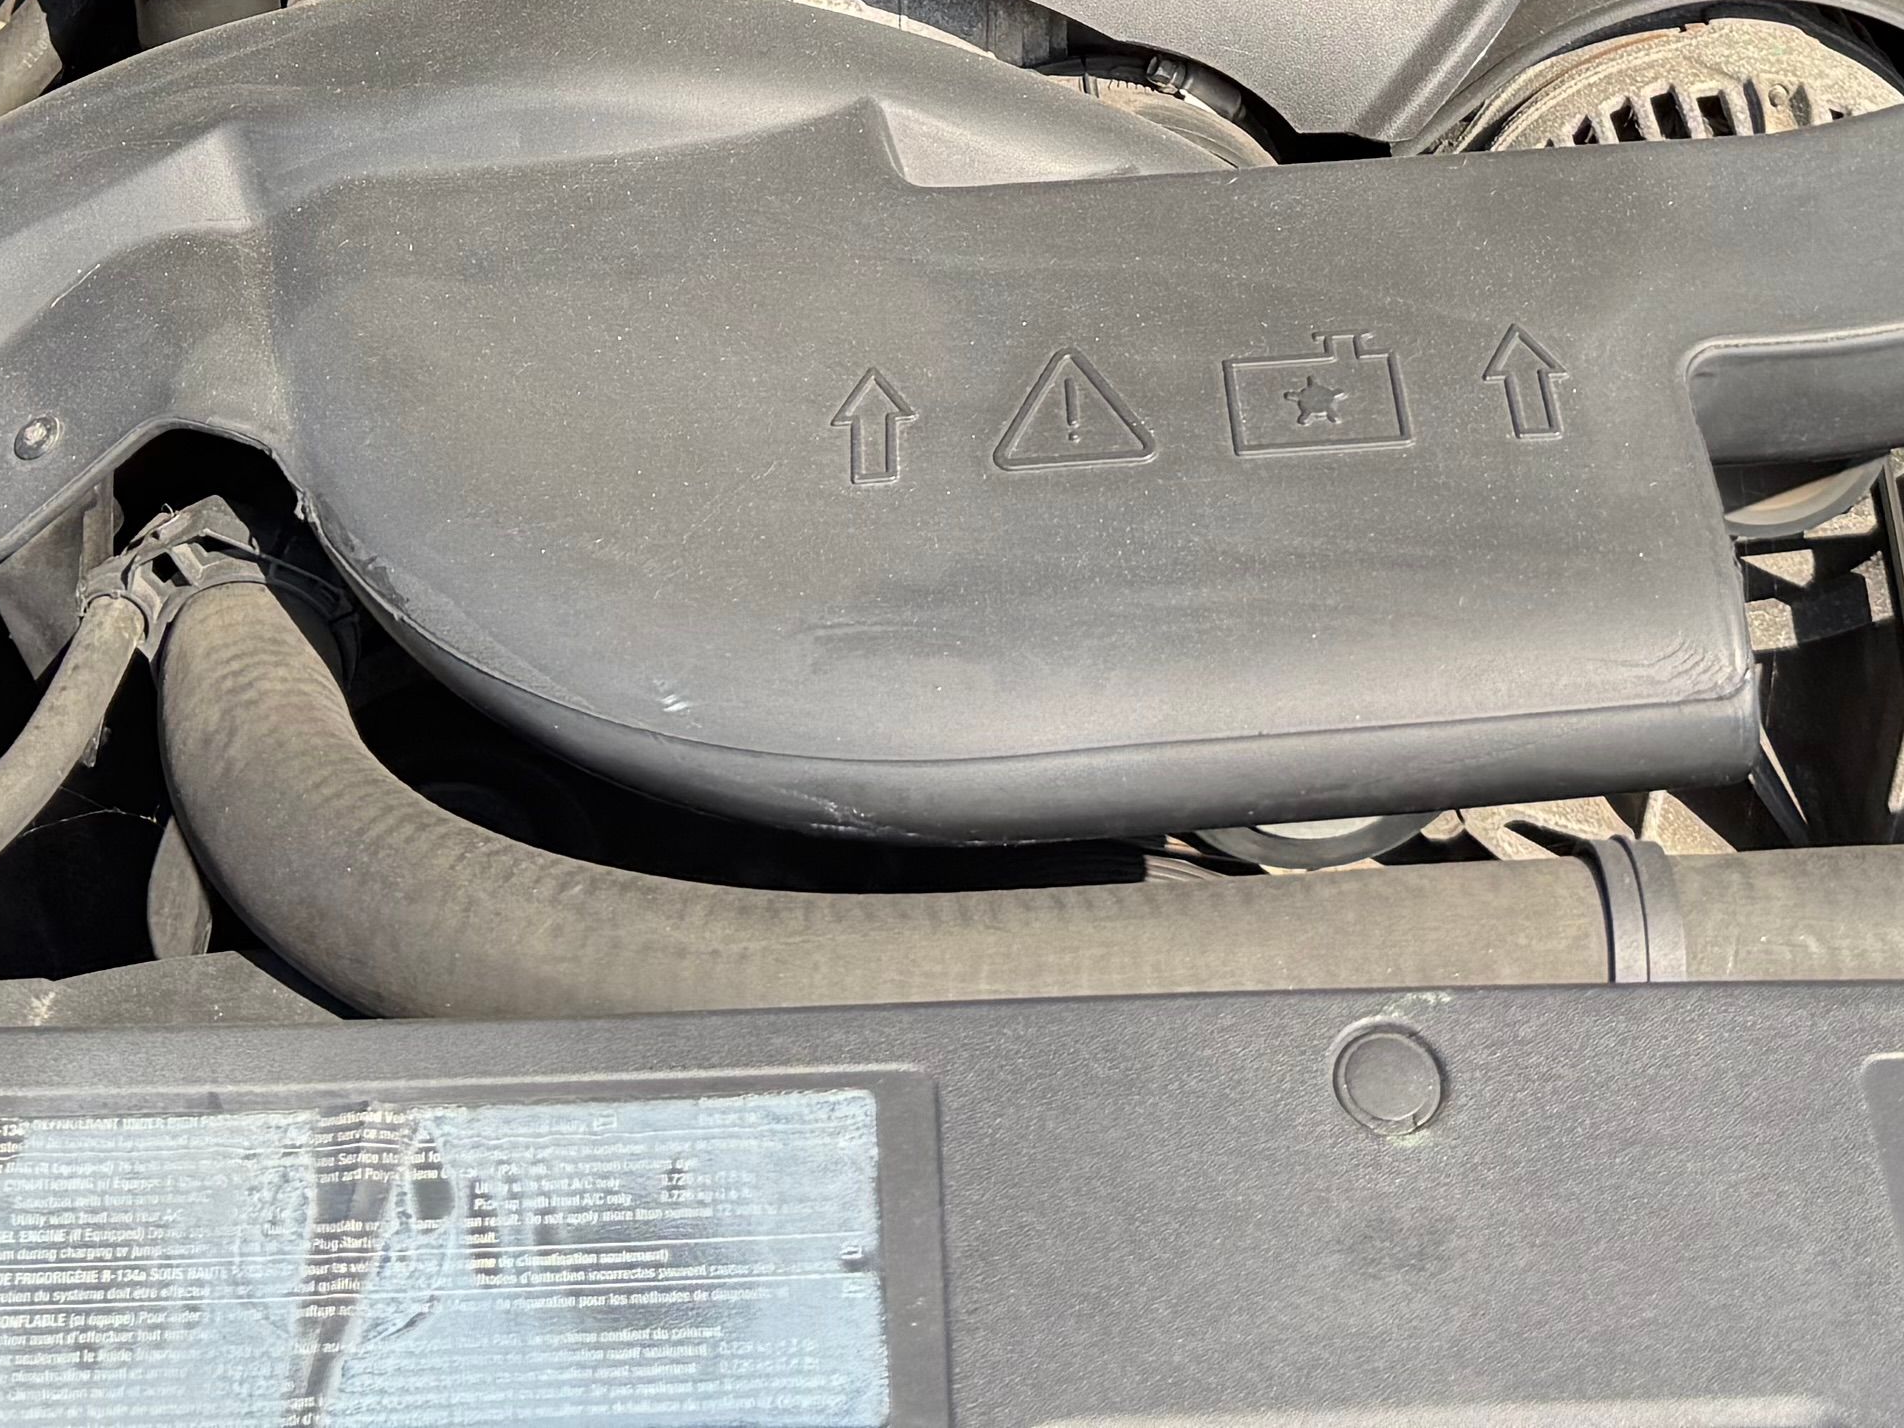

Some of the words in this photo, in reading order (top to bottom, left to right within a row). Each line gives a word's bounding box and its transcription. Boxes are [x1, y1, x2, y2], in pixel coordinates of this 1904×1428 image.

[582, 1193, 605, 1206] A/C
[607, 1193, 632, 1207] only
[50, 1212, 76, 1224] with
[566, 1211, 600, 1226] apply
[602, 1211, 634, 1222] more
[635, 1208, 662, 1220] than
[19, 1230, 66, 1243] ENGINE
[84, 1227, 145, 1243] Equipped)
[313, 1237, 339, 1252] Plug
[17, 1248, 57, 1263] during
[60, 1246, 113, 1261] charging
[101, 1269, 147, 1283] R-134a
[149, 1267, 184, 1281] SOUS
[587, 1267, 656, 1282] incorrectes
[34, 1290, 50, 1302] du
[107, 1286, 131, 1299] doit
[579, 1293, 608, 1309] pour
[609, 1292, 629, 1304] les
[693, 1288, 709, 1302] de
[138, 1311, 167, 1324] Pour
[30, 1332, 63, 1345] avant
[652, 1327, 670, 1341] du
